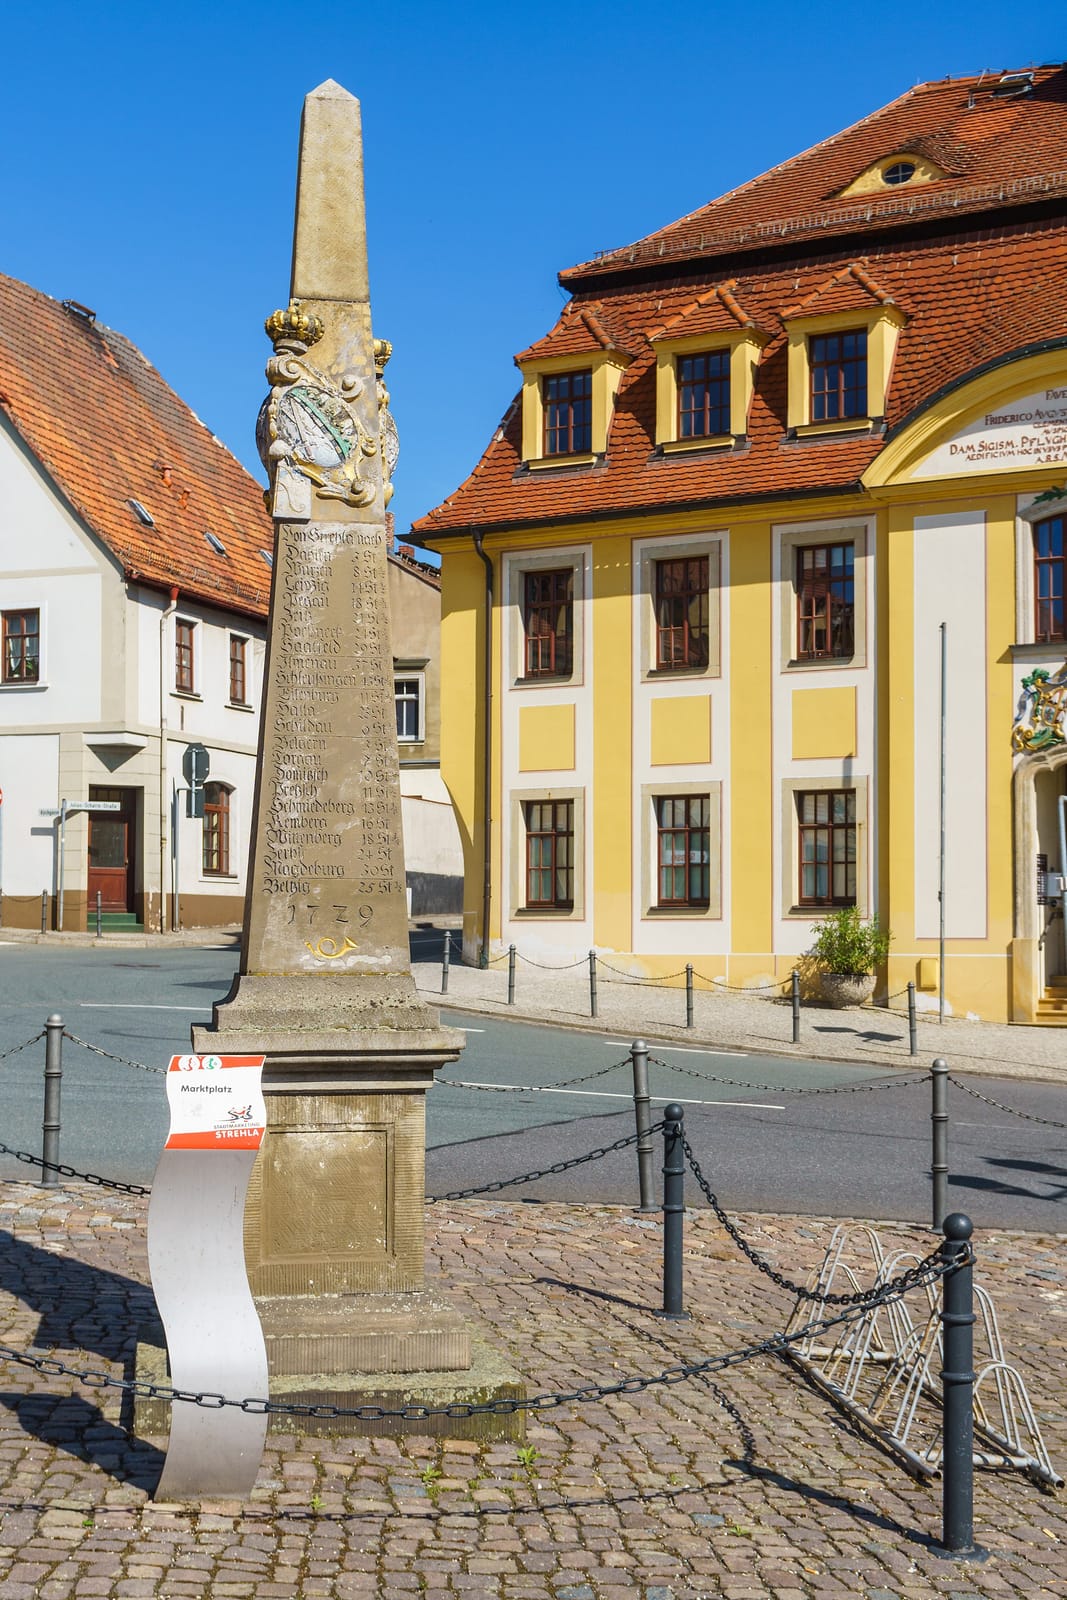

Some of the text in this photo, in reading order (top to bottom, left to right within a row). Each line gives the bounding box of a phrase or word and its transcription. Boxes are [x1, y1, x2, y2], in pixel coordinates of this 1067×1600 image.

[985, 413, 1032, 425] FRIDERICO
[950, 444, 975, 455] DAM
[263, 856, 345, 878] Magdeburg
[180, 1084, 233, 1094] Marktplatz
[215, 1128, 260, 1139] STREHLA
